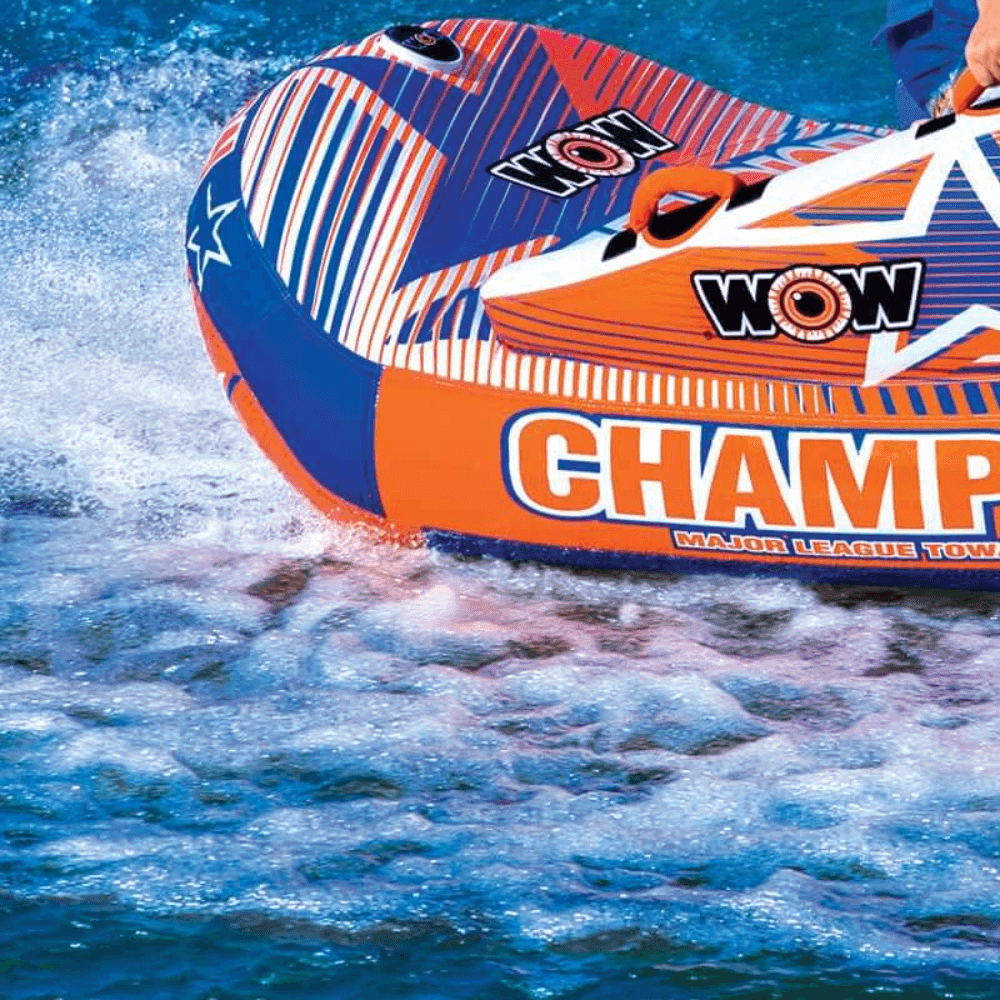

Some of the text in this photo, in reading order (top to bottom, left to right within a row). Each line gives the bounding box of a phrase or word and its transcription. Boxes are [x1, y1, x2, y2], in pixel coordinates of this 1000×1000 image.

[489, 109, 676, 197] WOW
[695, 264, 920, 342] WOW
[674, 530, 790, 553] MAJOR
[792, 537, 918, 559] LEAGUE
